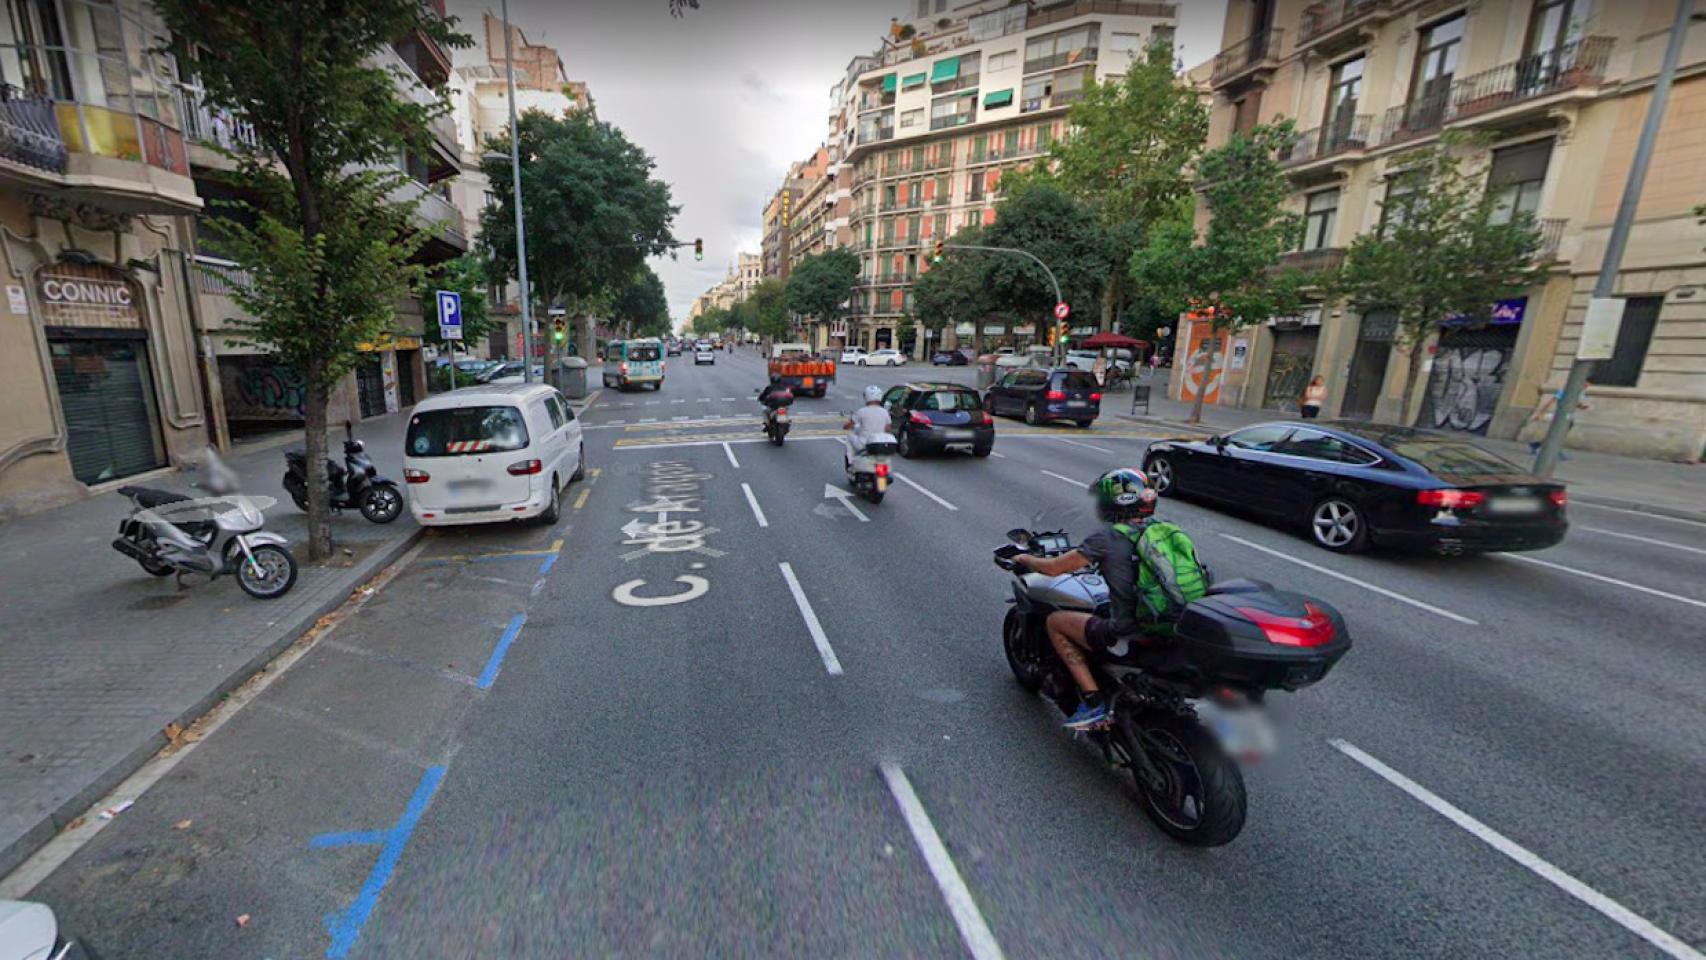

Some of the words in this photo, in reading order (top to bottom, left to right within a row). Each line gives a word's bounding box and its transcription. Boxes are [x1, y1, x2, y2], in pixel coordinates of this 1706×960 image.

[43, 280, 131, 304] CONNIC
[442, 295, 456, 323] P
[620, 519, 705, 552] de
[613, 562, 710, 606] C.
